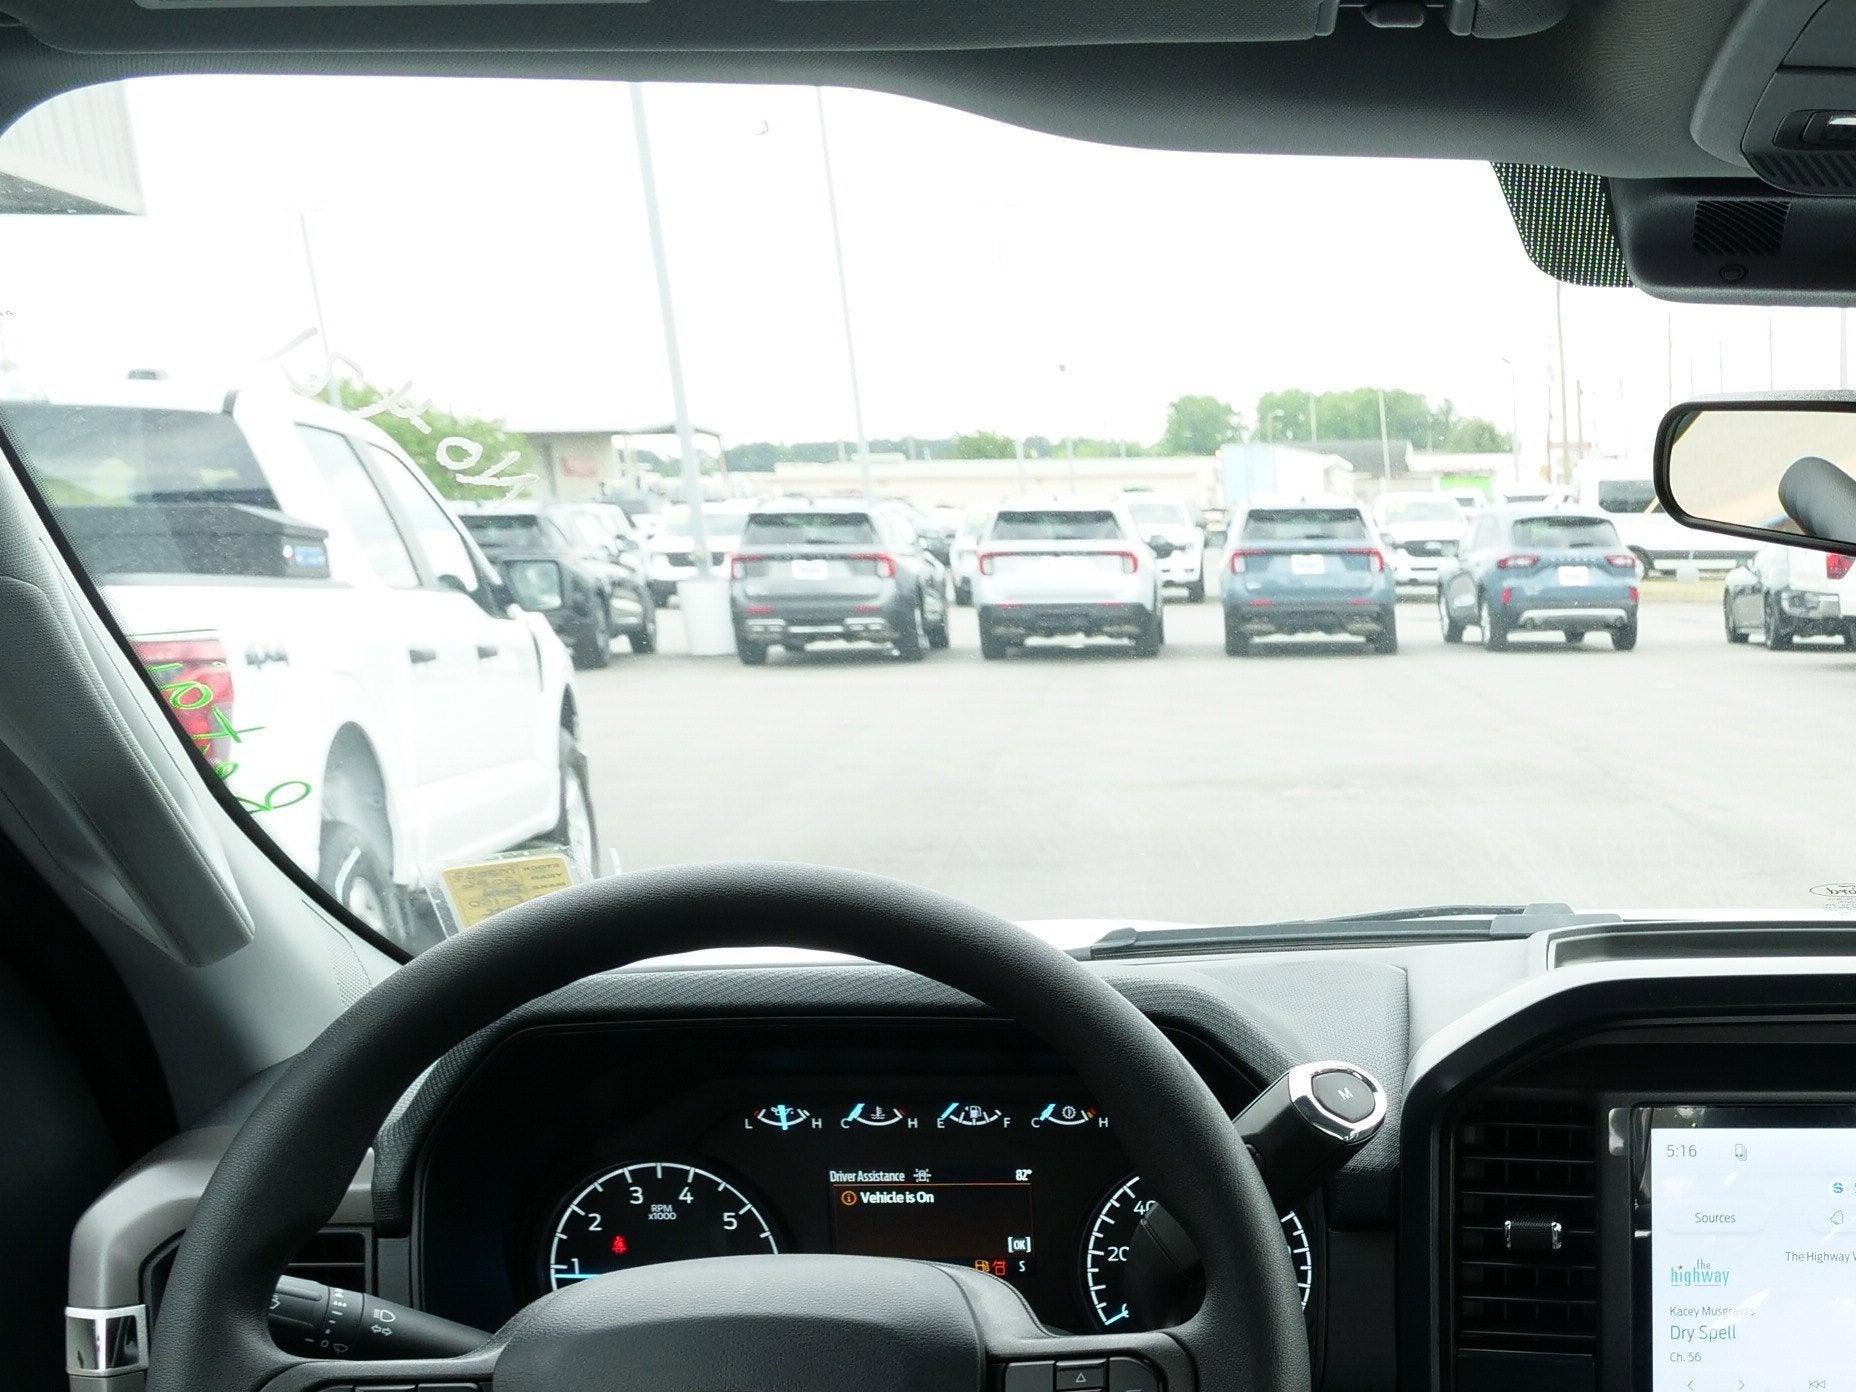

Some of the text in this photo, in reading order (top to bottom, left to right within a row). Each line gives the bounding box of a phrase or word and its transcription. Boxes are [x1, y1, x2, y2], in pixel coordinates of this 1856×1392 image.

[1337, 1087, 1353, 1100] M
[745, 1118, 753, 1129] L
[812, 1118, 822, 1128] H
[841, 1118, 850, 1128] C
[908, 1118, 918, 1128] H
[937, 1118, 945, 1128] E
[1004, 1118, 1011, 1128] F
[1031, 1117, 1040, 1128] C
[1099, 1117, 1108, 1128] H
[1666, 1144, 1697, 1158] 5:16
[829, 1170, 856, 1182] Driver
[857, 1170, 905, 1182] Assistance
[629, 1186, 644, 1205] 3
[679, 1186, 694, 1204] 4
[860, 1192, 934, 1204] Vehicle is On
[651, 1204, 673, 1213] RPM
[648, 1212, 676, 1220] x1000
[723, 1213, 737, 1230] 5
[1694, 1212, 1736, 1224] Sources
[588, 1214, 602, 1231] 2
[1785, 1251, 1804, 1262] The
[1806, 1251, 1850, 1264] Highway
[1696, 1258, 1711, 1270] the
[1670, 1266, 1730, 1286] highway
[1669, 1306, 1755, 1318] Kacey Musgraves
[1670, 1325, 1736, 1342] Dry Spell
[1670, 1352, 1701, 1362] Ch. 56
